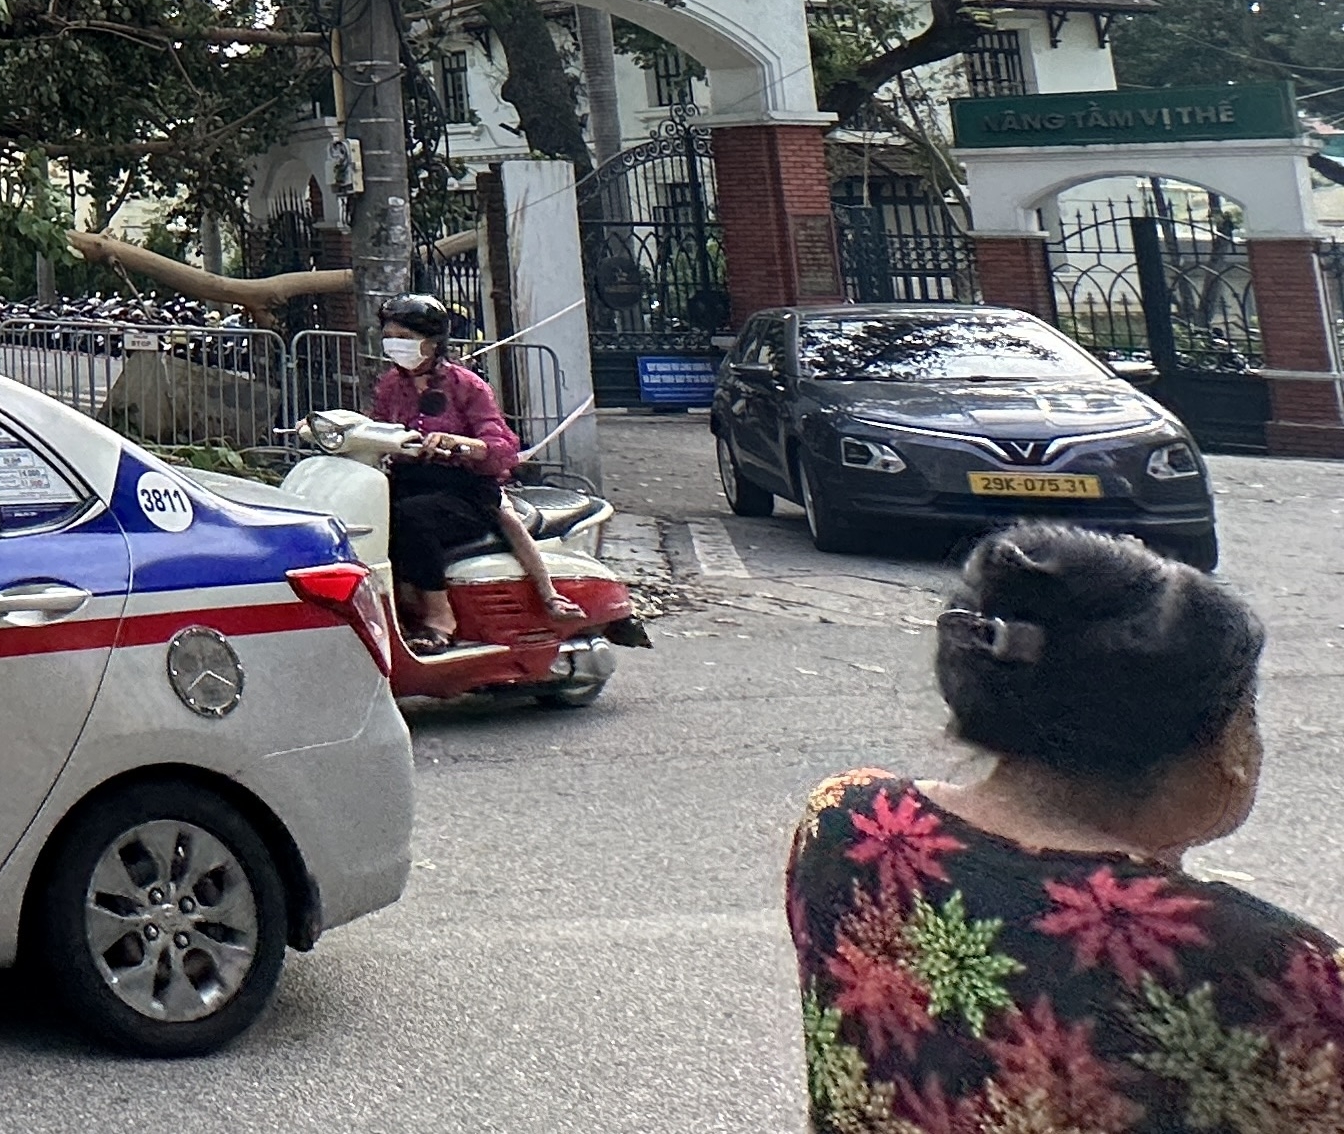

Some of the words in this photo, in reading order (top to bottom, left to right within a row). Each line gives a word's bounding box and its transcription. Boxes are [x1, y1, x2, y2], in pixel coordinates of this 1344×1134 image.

[983, 110, 1066, 132] NÂNG
[1137, 107, 1172, 131] VỊ
[1174, 94, 1239, 125] THẾ
[979, 477, 1088, 494] 29K-075.31
[141, 488, 187, 513] 3811
